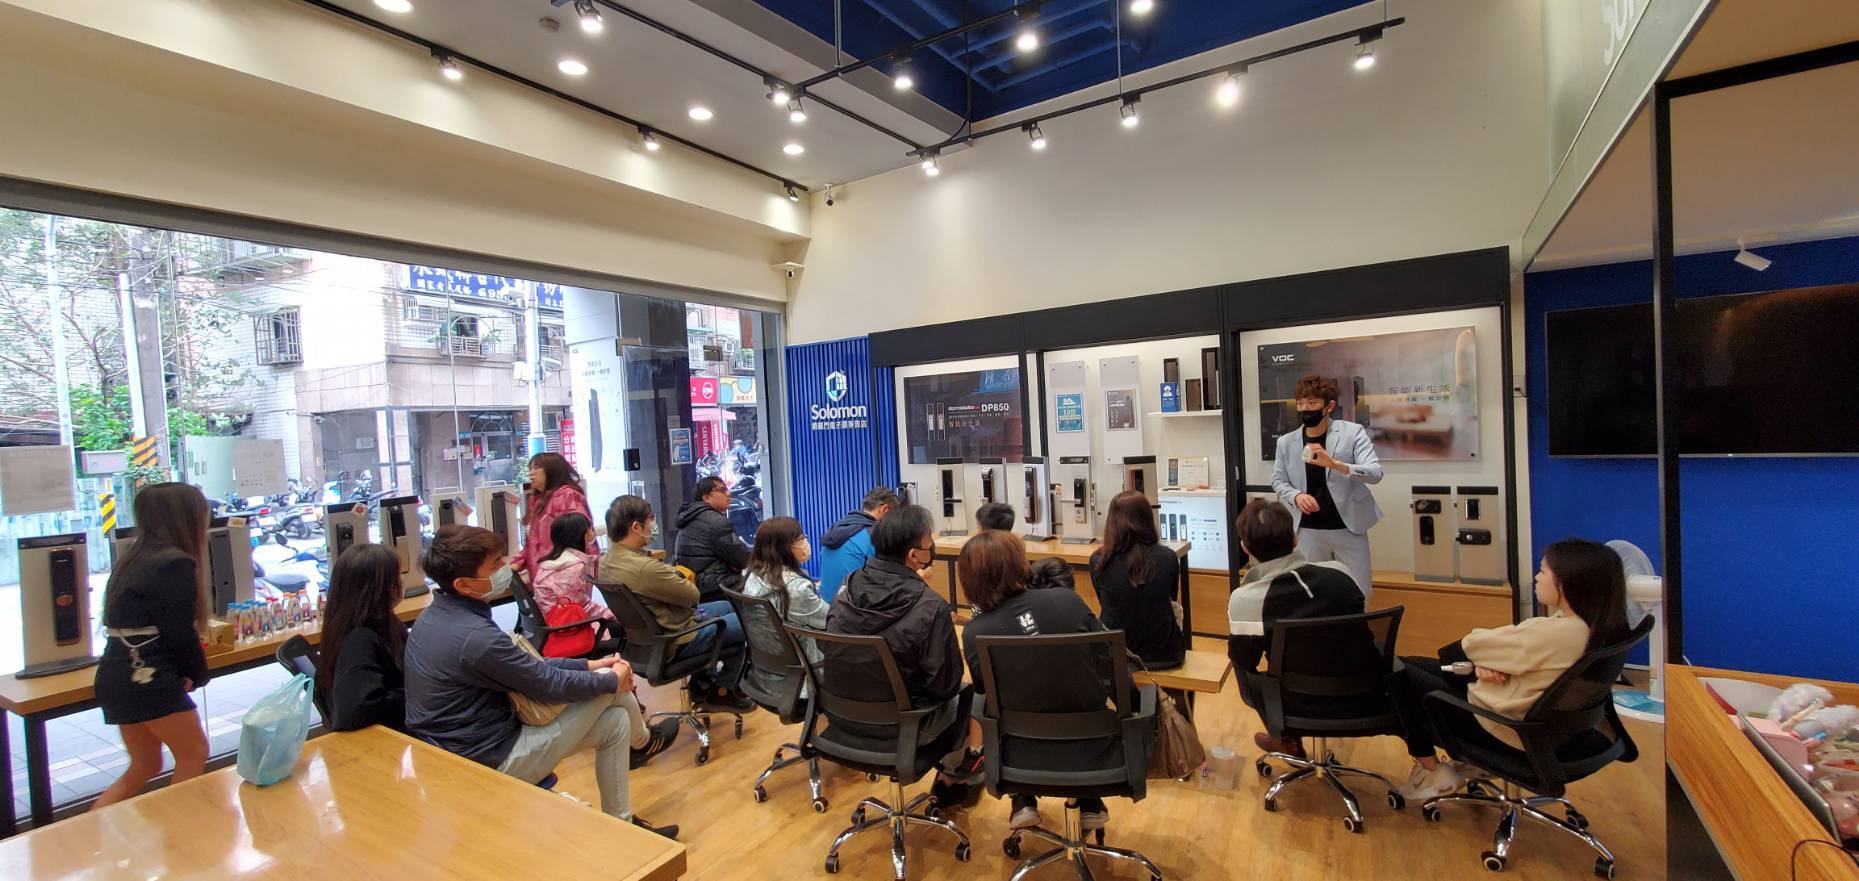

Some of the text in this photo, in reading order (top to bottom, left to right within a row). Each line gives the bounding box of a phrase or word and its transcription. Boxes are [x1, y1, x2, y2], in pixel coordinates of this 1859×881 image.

[1272, 354, 1294, 362] VOC
[811, 403, 867, 420] Solomon
[981, 403, 1009, 412] DP850
